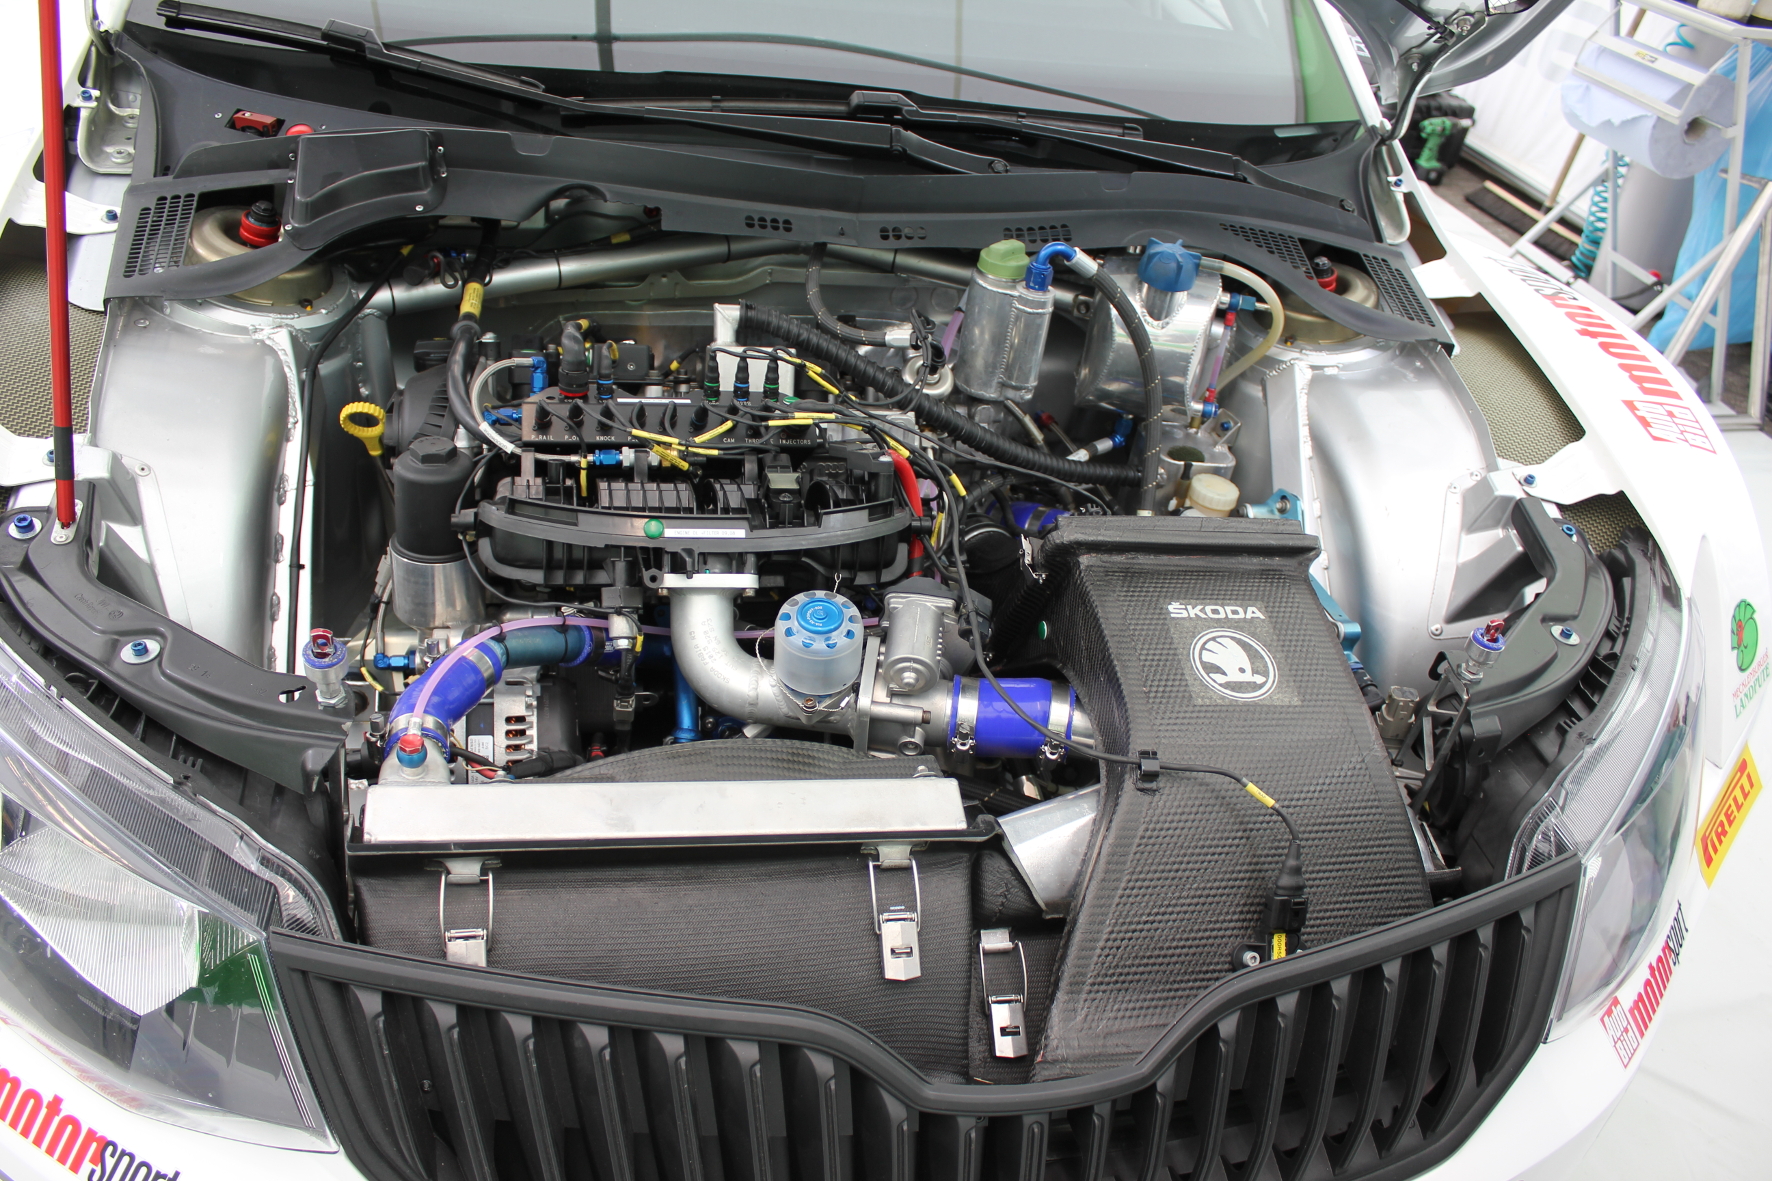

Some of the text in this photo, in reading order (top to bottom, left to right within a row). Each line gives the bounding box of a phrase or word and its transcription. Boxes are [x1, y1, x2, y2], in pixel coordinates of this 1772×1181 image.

[1167, 601, 1266, 619] ŠKODA
[1734, 662, 1770, 719] LANDPUTE
[1700, 757, 1755, 869] PIRELLI
[1628, 899, 1689, 1040] motorsport
